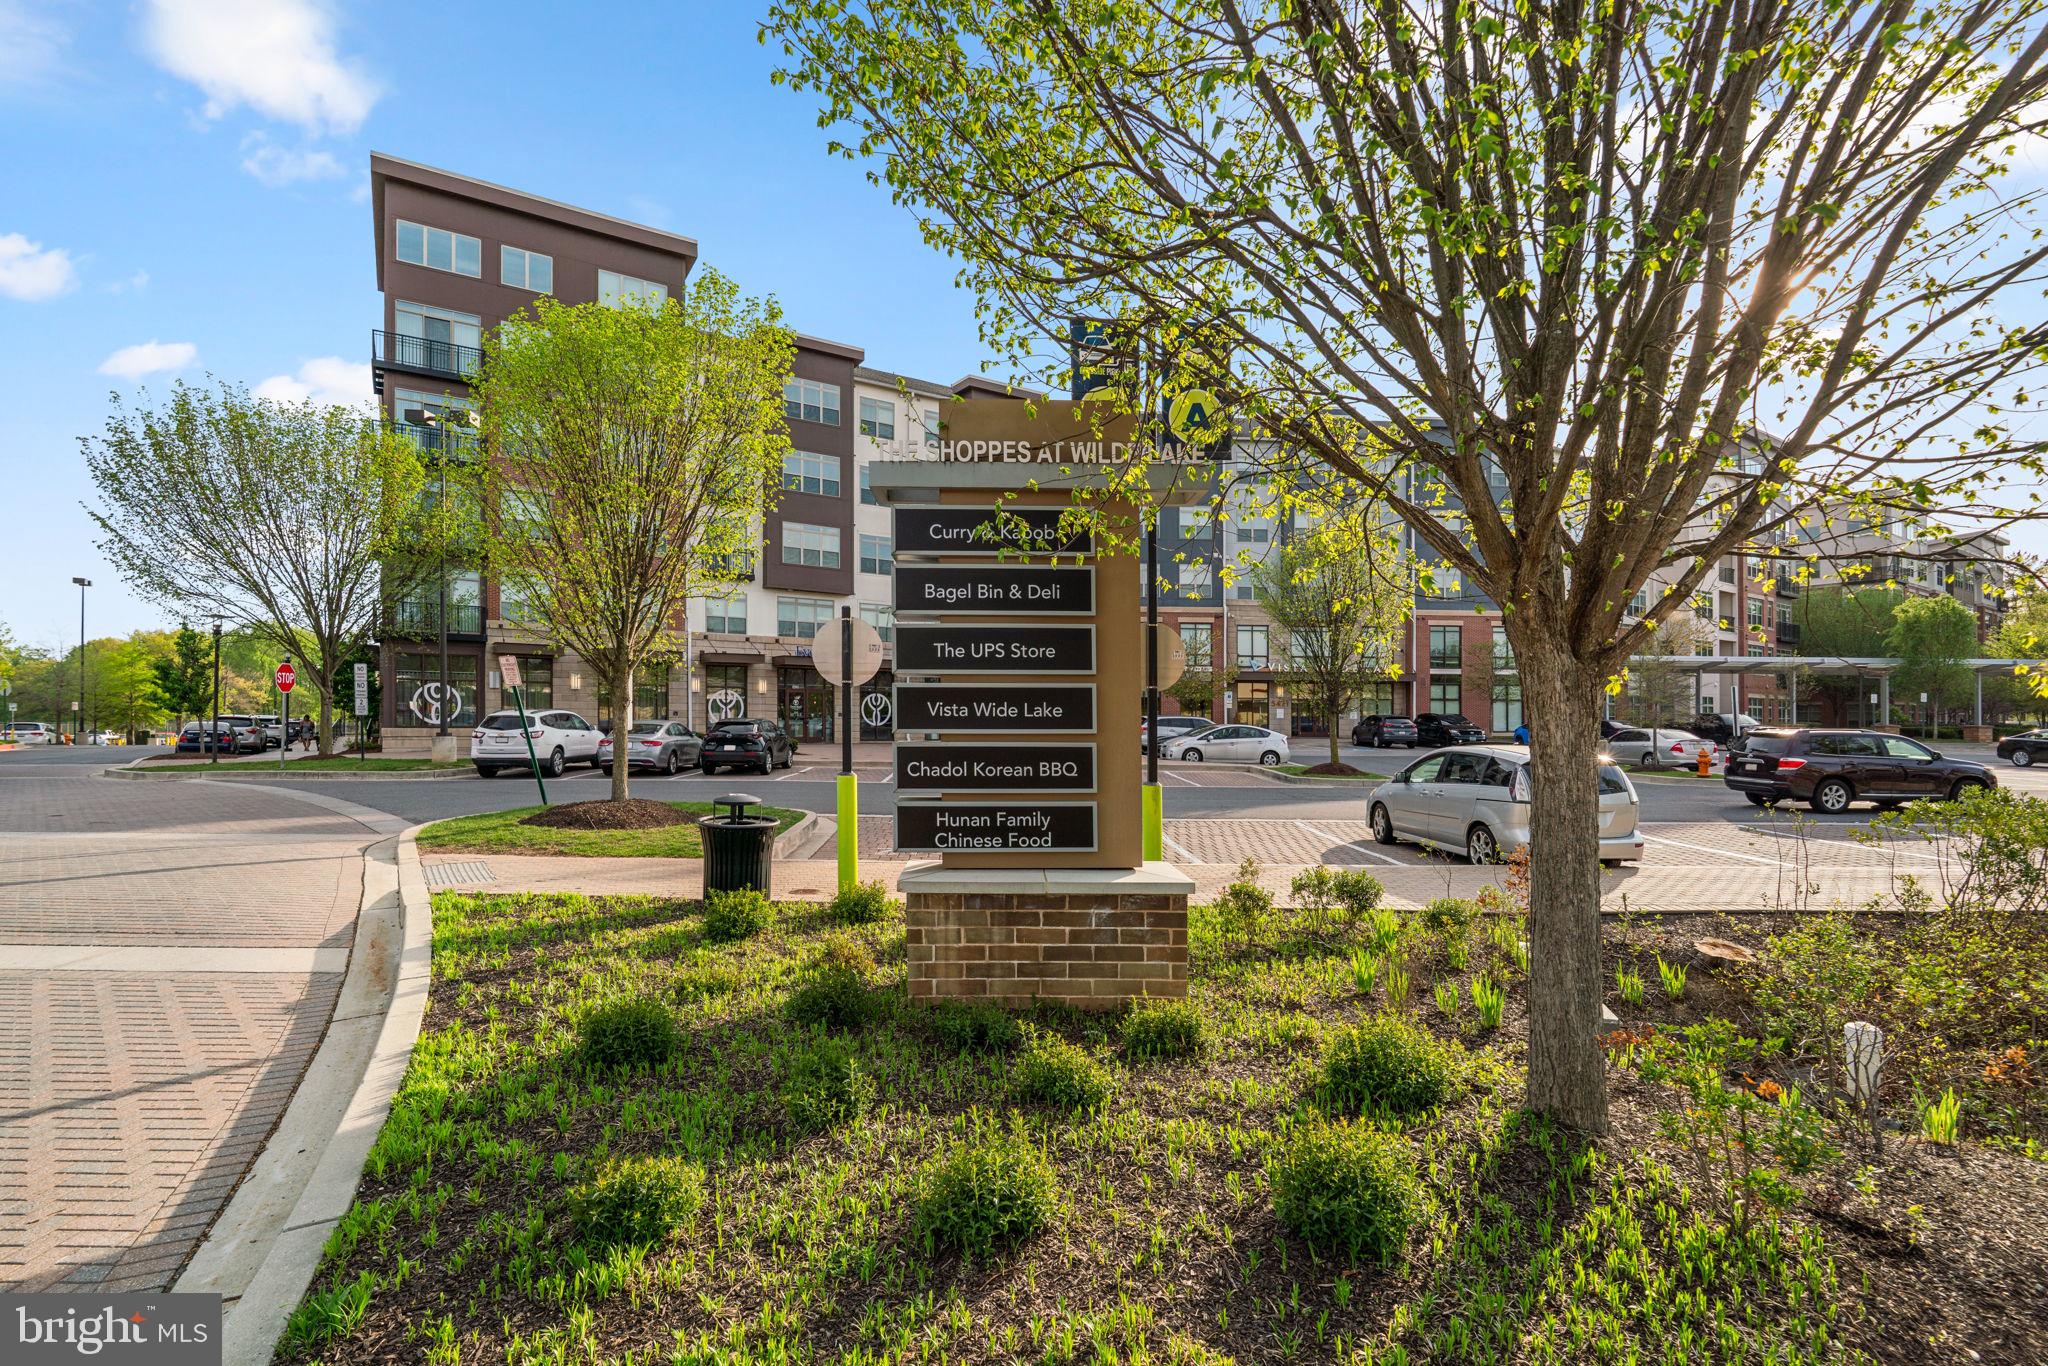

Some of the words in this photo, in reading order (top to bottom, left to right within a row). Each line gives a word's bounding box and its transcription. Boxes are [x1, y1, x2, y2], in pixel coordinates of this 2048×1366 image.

[1181, 402, 1211, 432] A
[876, 440, 918, 462] THE
[926, 440, 1031, 463] SHOPPES
[1036, 440, 1064, 463] AT
[929, 523, 975, 544] Curry
[924, 583, 972, 603] Bagel
[977, 583, 1003, 599] Bin
[1009, 583, 1022, 599] &
[1028, 583, 1060, 599] Deli
[933, 642, 966, 658] The
[971, 642, 1005, 658] UPS
[1010, 642, 1056, 658] Store
[277, 672, 295, 684] STOP
[926, 701, 969, 717] Vista
[973, 701, 1018, 718] Wide
[1024, 701, 1063, 718] Lake
[907, 761, 967, 777] Chadol
[973, 761, 1033, 777] Korean
[1039, 761, 1078, 777] BBQ
[936, 811, 991, 827] Hunan
[996, 810, 1051, 831] Family
[934, 832, 1003, 848] Chinese
[1008, 832, 1052, 848] Food
